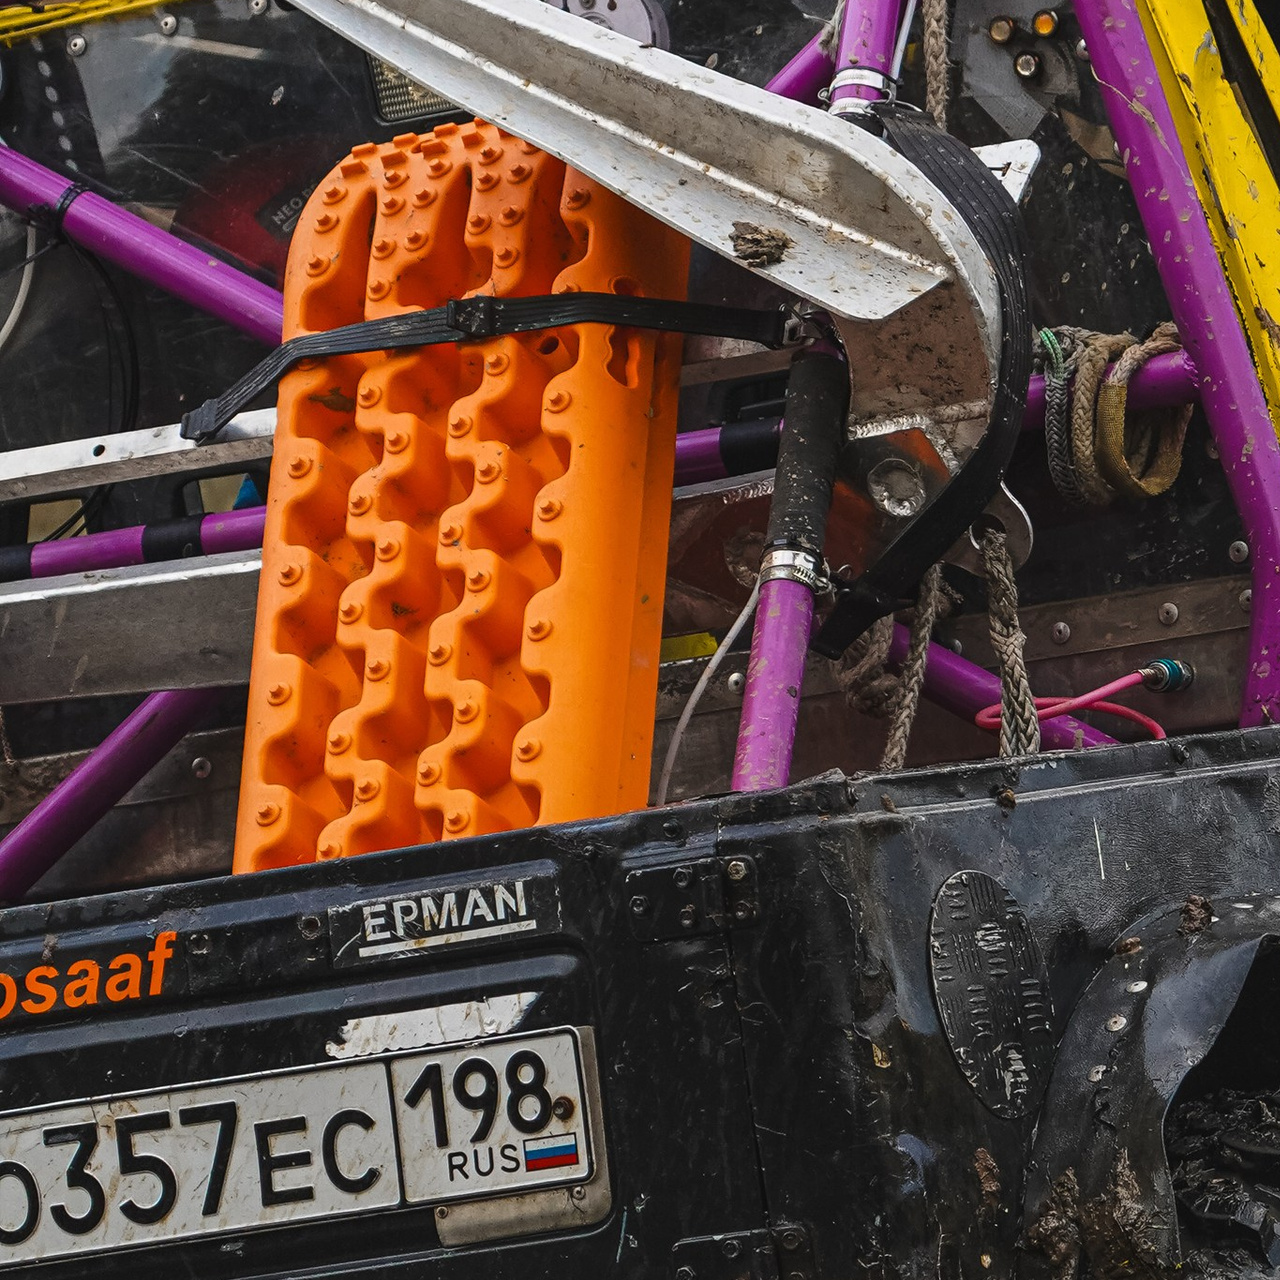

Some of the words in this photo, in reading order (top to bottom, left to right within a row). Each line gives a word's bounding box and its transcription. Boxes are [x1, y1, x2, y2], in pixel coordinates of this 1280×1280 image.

[362, 881, 527, 942] EPMAN
[403, 1049, 554, 1149] 198
[447, 1143, 521, 1182] RUS
